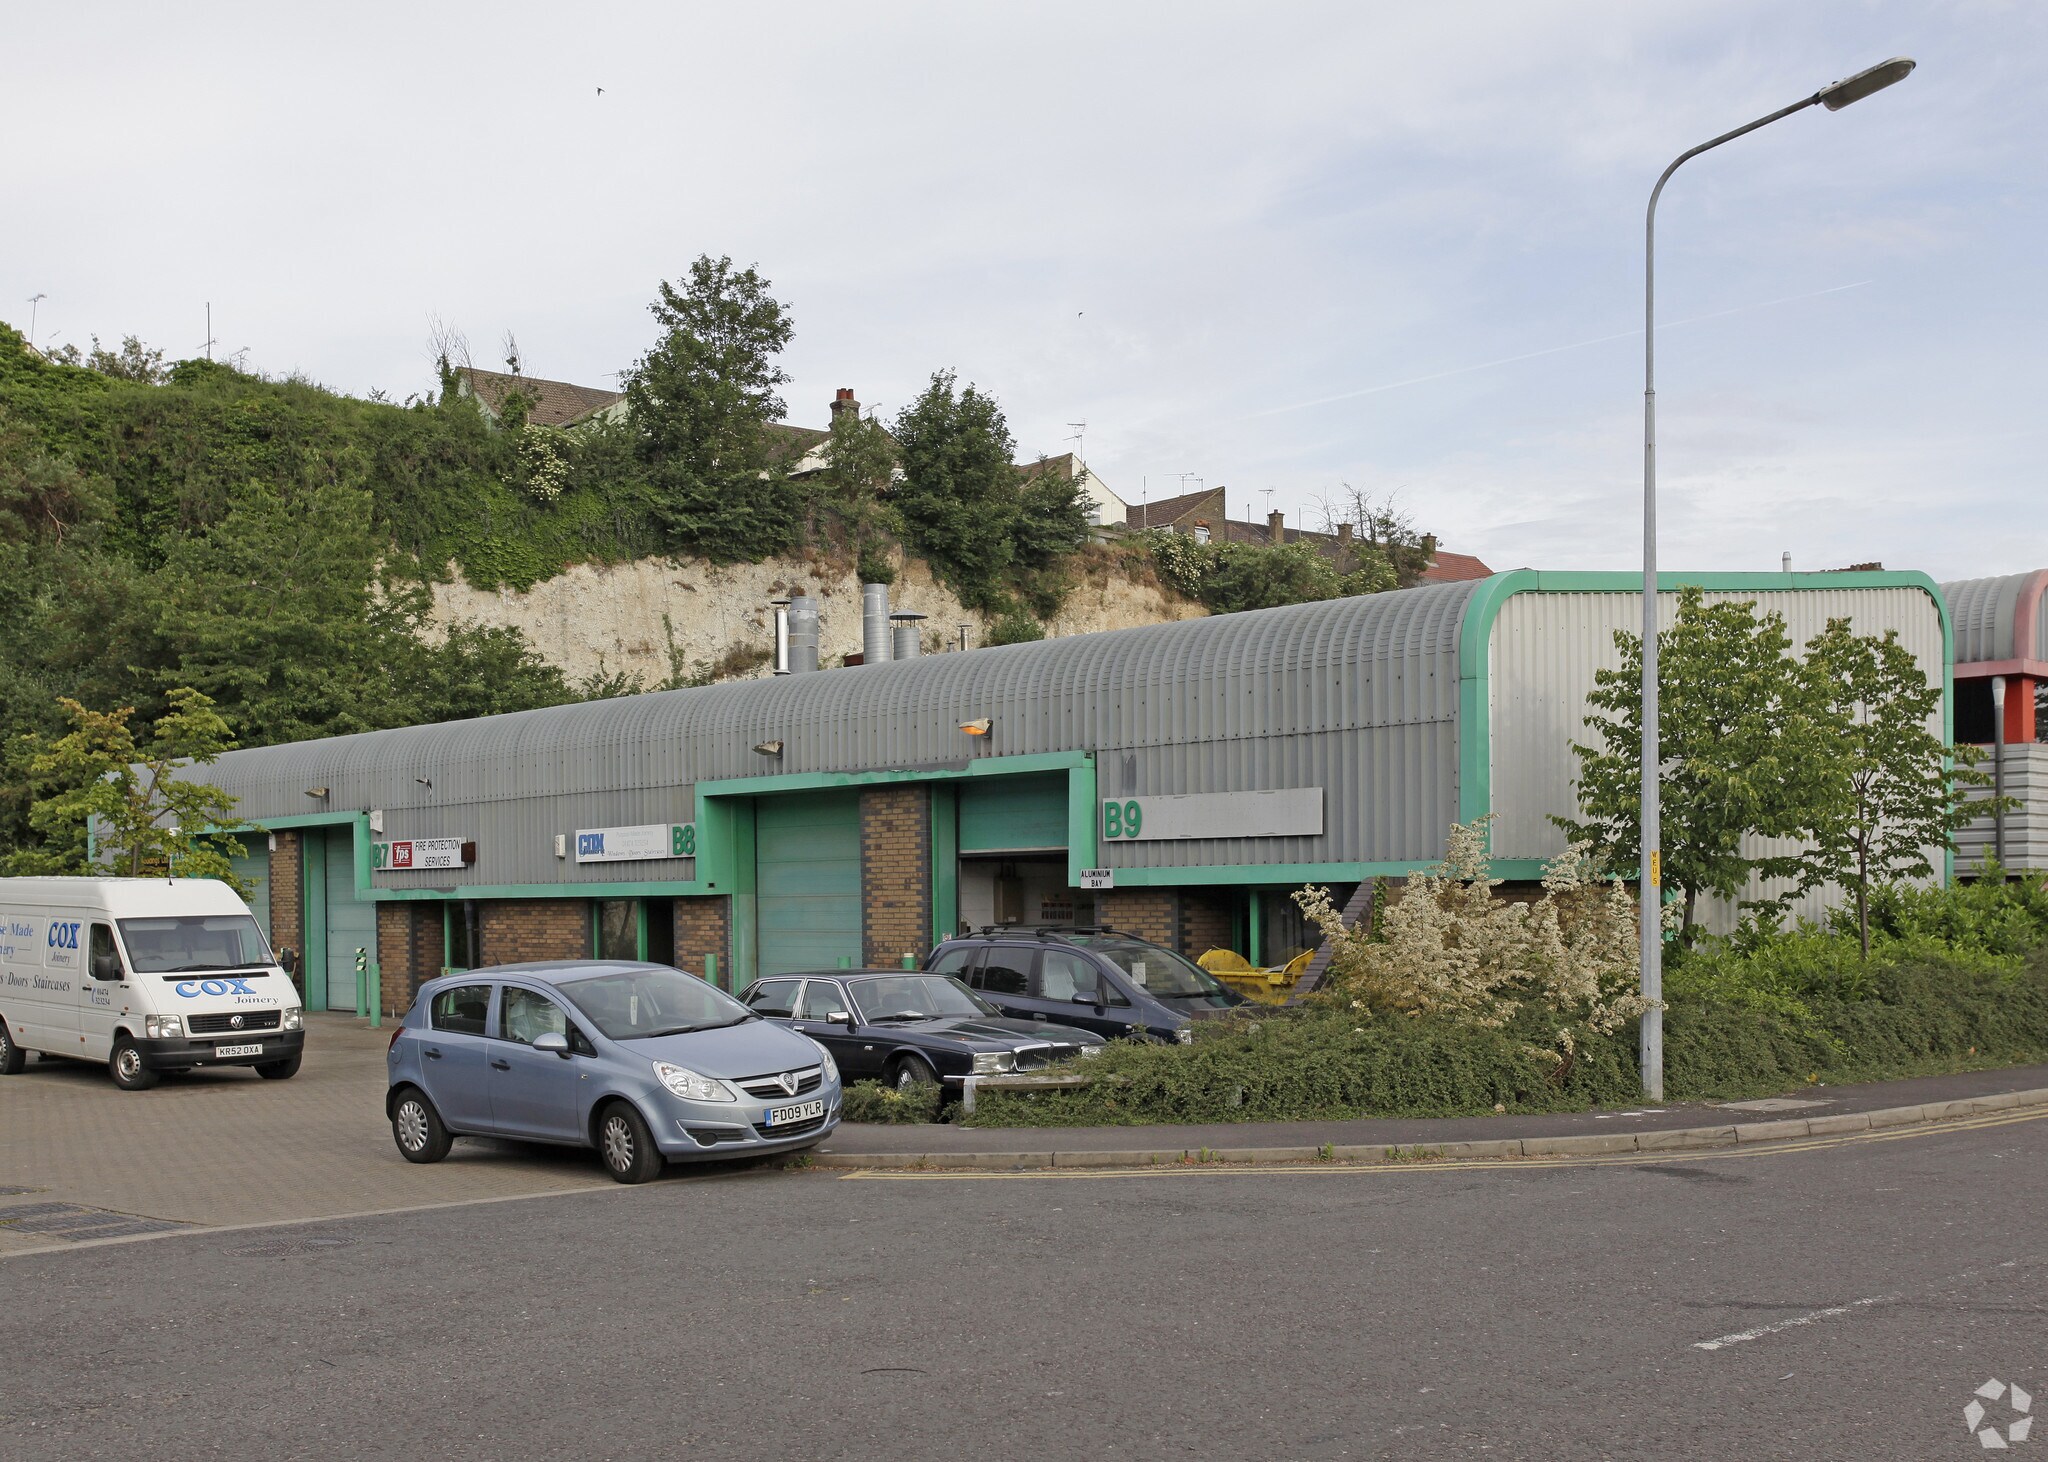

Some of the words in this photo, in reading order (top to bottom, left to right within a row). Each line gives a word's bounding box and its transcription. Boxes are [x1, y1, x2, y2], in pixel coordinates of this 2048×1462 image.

[1104, 800, 1142, 838] B9
[415, 841, 426, 851] FIRE
[427, 839, 460, 850] PROTECTION
[578, 833, 605, 855] COX
[672, 825, 695, 856] B8
[372, 843, 389, 868] B7
[396, 845, 409, 863] fps
[424, 855, 451, 867] SERVICES
[1081, 869, 1111, 878] ALUMINIUM
[1091, 879, 1103, 888] BAY
[10, 922, 34, 937] Made
[48, 921, 81, 949] COX
[51, 951, 71, 966] Joinery
[8, 971, 29, 988] Doors
[33, 973, 71, 992] Staircases
[175, 978, 257, 998] COX
[234, 995, 279, 1006] Joinery
[219, 1046, 242, 1056] KR52
[243, 1044, 260, 1055] OXA
[772, 1106, 801, 1123] FD09
[803, 1101, 822, 1116] YLR
